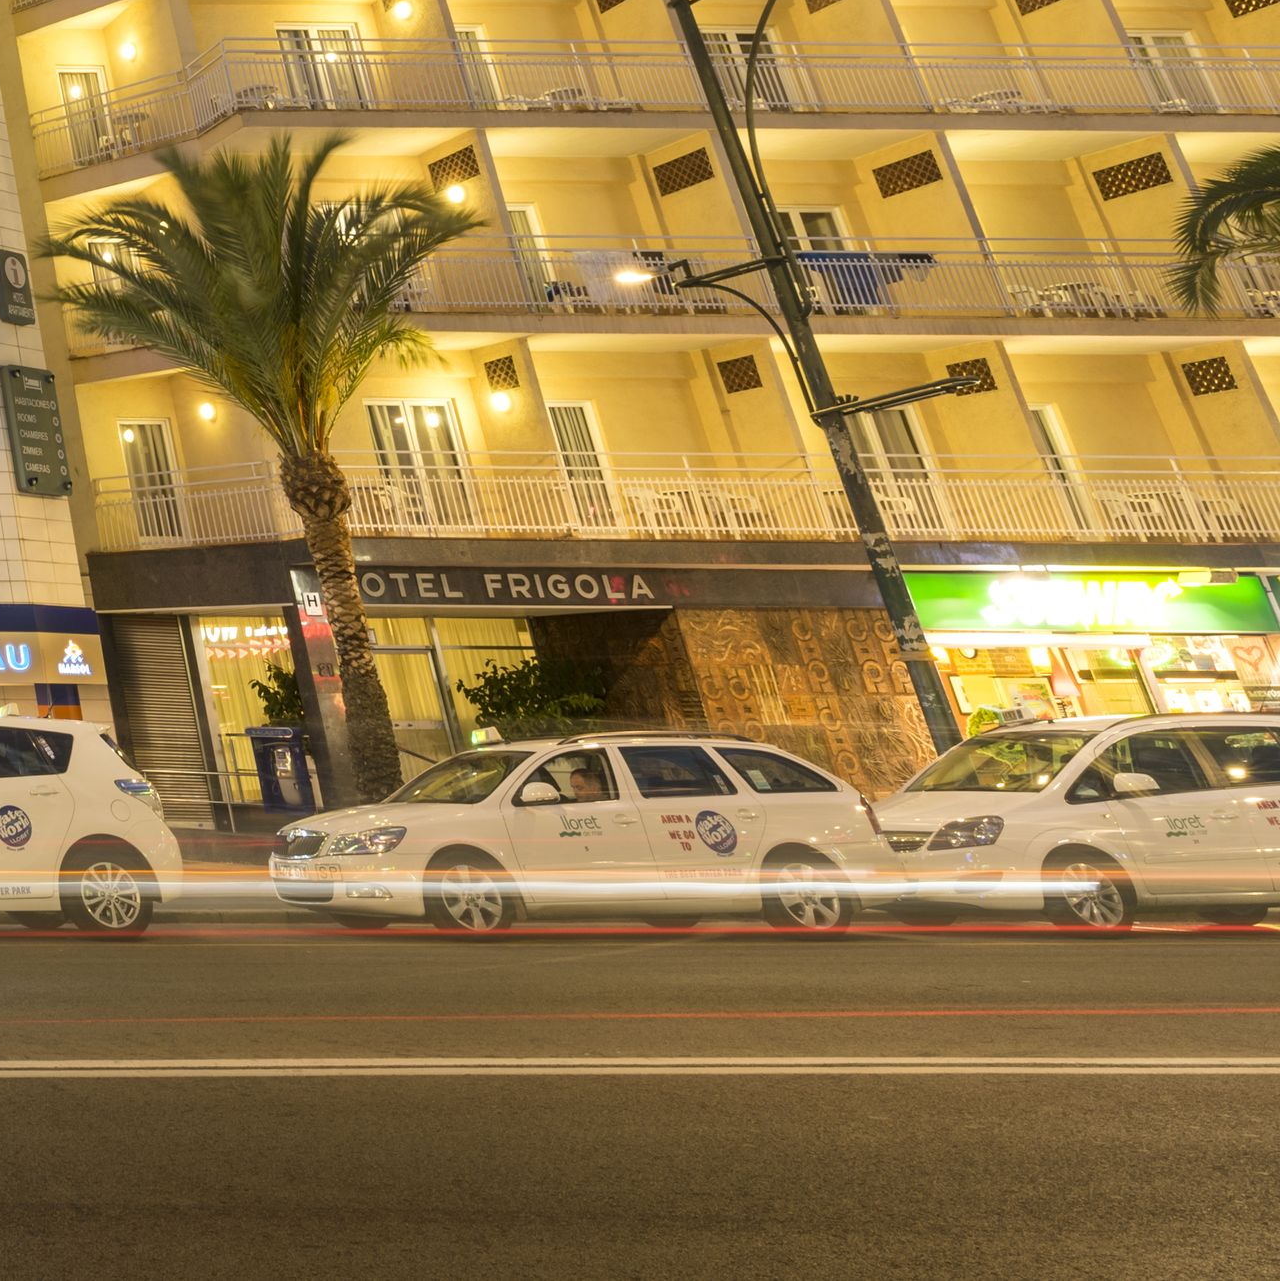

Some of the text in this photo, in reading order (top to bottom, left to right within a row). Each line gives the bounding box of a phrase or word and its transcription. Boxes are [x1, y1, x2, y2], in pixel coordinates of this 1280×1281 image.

[14, 397, 51, 409] HABITACIONES
[16, 413, 37, 423] ROOMS
[19, 429, 49, 441] CHAMBRES
[22, 445, 43, 456] ZIMMER
[360, 572, 656, 600] OTEL FRIGOLA
[307, 594, 319, 608] H
[560, 814, 602, 831] lloret
[660, 814, 692, 825] ANEM A
[668, 829, 696, 840] WE GO
[679, 841, 692, 852] TO
[318, 866, 338, 879] SP
[11, 885, 32, 896] PARK
